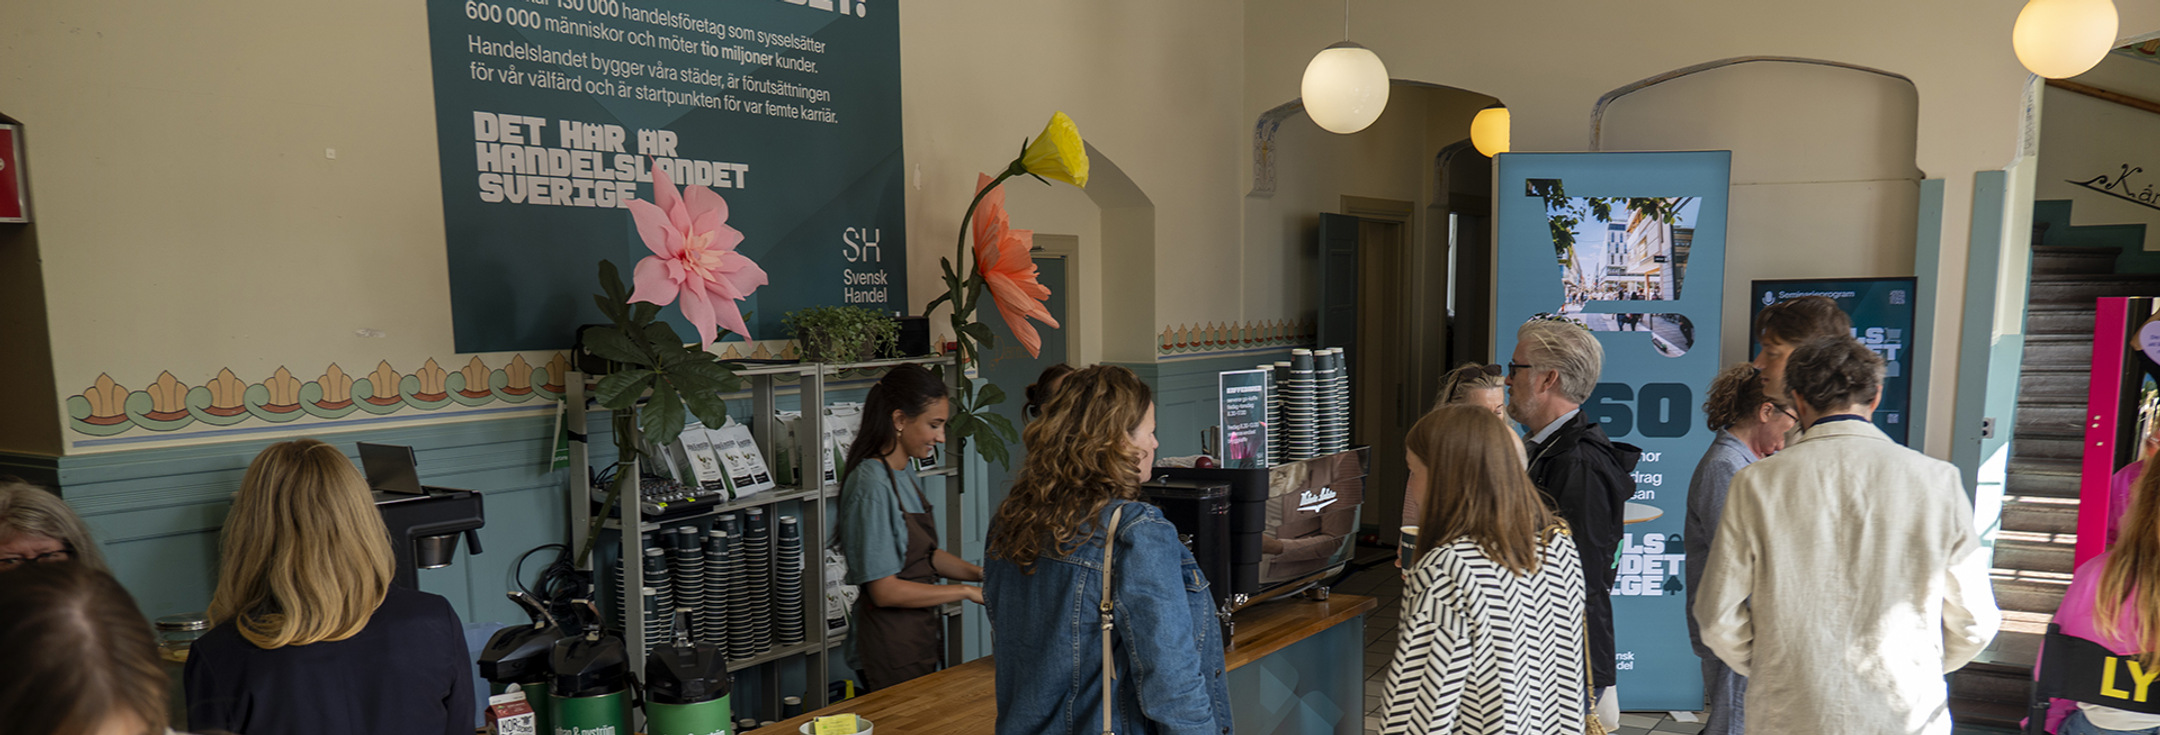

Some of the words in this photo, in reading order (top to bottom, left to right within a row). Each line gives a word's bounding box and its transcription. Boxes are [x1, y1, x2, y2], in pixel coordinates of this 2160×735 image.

[465, 0, 503, 24] 600
[505, 6, 541, 30] 000
[545, 16, 625, 43] människor
[627, 30, 656, 48] och
[658, 34, 699, 55] möter
[701, 40, 719, 58] tio
[721, 45, 774, 66] miljoner
[775, 52, 818, 74] kunder.
[587, 0, 619, 17] 000
[622, 3, 725, 40] handelsföretag
[728, 24, 755, 42] som
[757, 30, 826, 54] sysselsätter
[468, 34, 588, 69] Handelslandet
[591, 52, 644, 79] bygger
[648, 60, 678, 81] våra
[680, 67, 725, 89] städer,
[727, 72, 740, 90] är
[742, 75, 831, 104] förutsättningen
[470, 61, 494, 82] för
[498, 64, 524, 86] vår
[527, 69, 582, 93] välfärd
[585, 79, 615, 96] och
[617, 80, 632, 98] är
[635, 84, 721, 109] startpunkten
[724, 95, 741, 112] för
[743, 101, 763, 114] var
[765, 102, 799, 119] femte
[800, 105, 838, 124] karriär.
[472, 110, 547, 146] DET
[475, 141, 749, 189] HANDELSLANDET
[478, 172, 638, 209] SVERIGE
[843, 226, 880, 262] SH
[843, 268, 888, 286] Svensk
[844, 287, 887, 303] Handel
[1850, 327, 1885, 344] LS
[1580, 383, 1692, 438] 60
[1639, 451, 1661, 462] nor
[1630, 471, 1662, 486] drag
[1630, 490, 1655, 500] san
[1622, 533, 1665, 554] LS
[1617, 554, 1686, 575] DET
[1615, 651, 1635, 660] nsk
[1616, 661, 1634, 670] del
